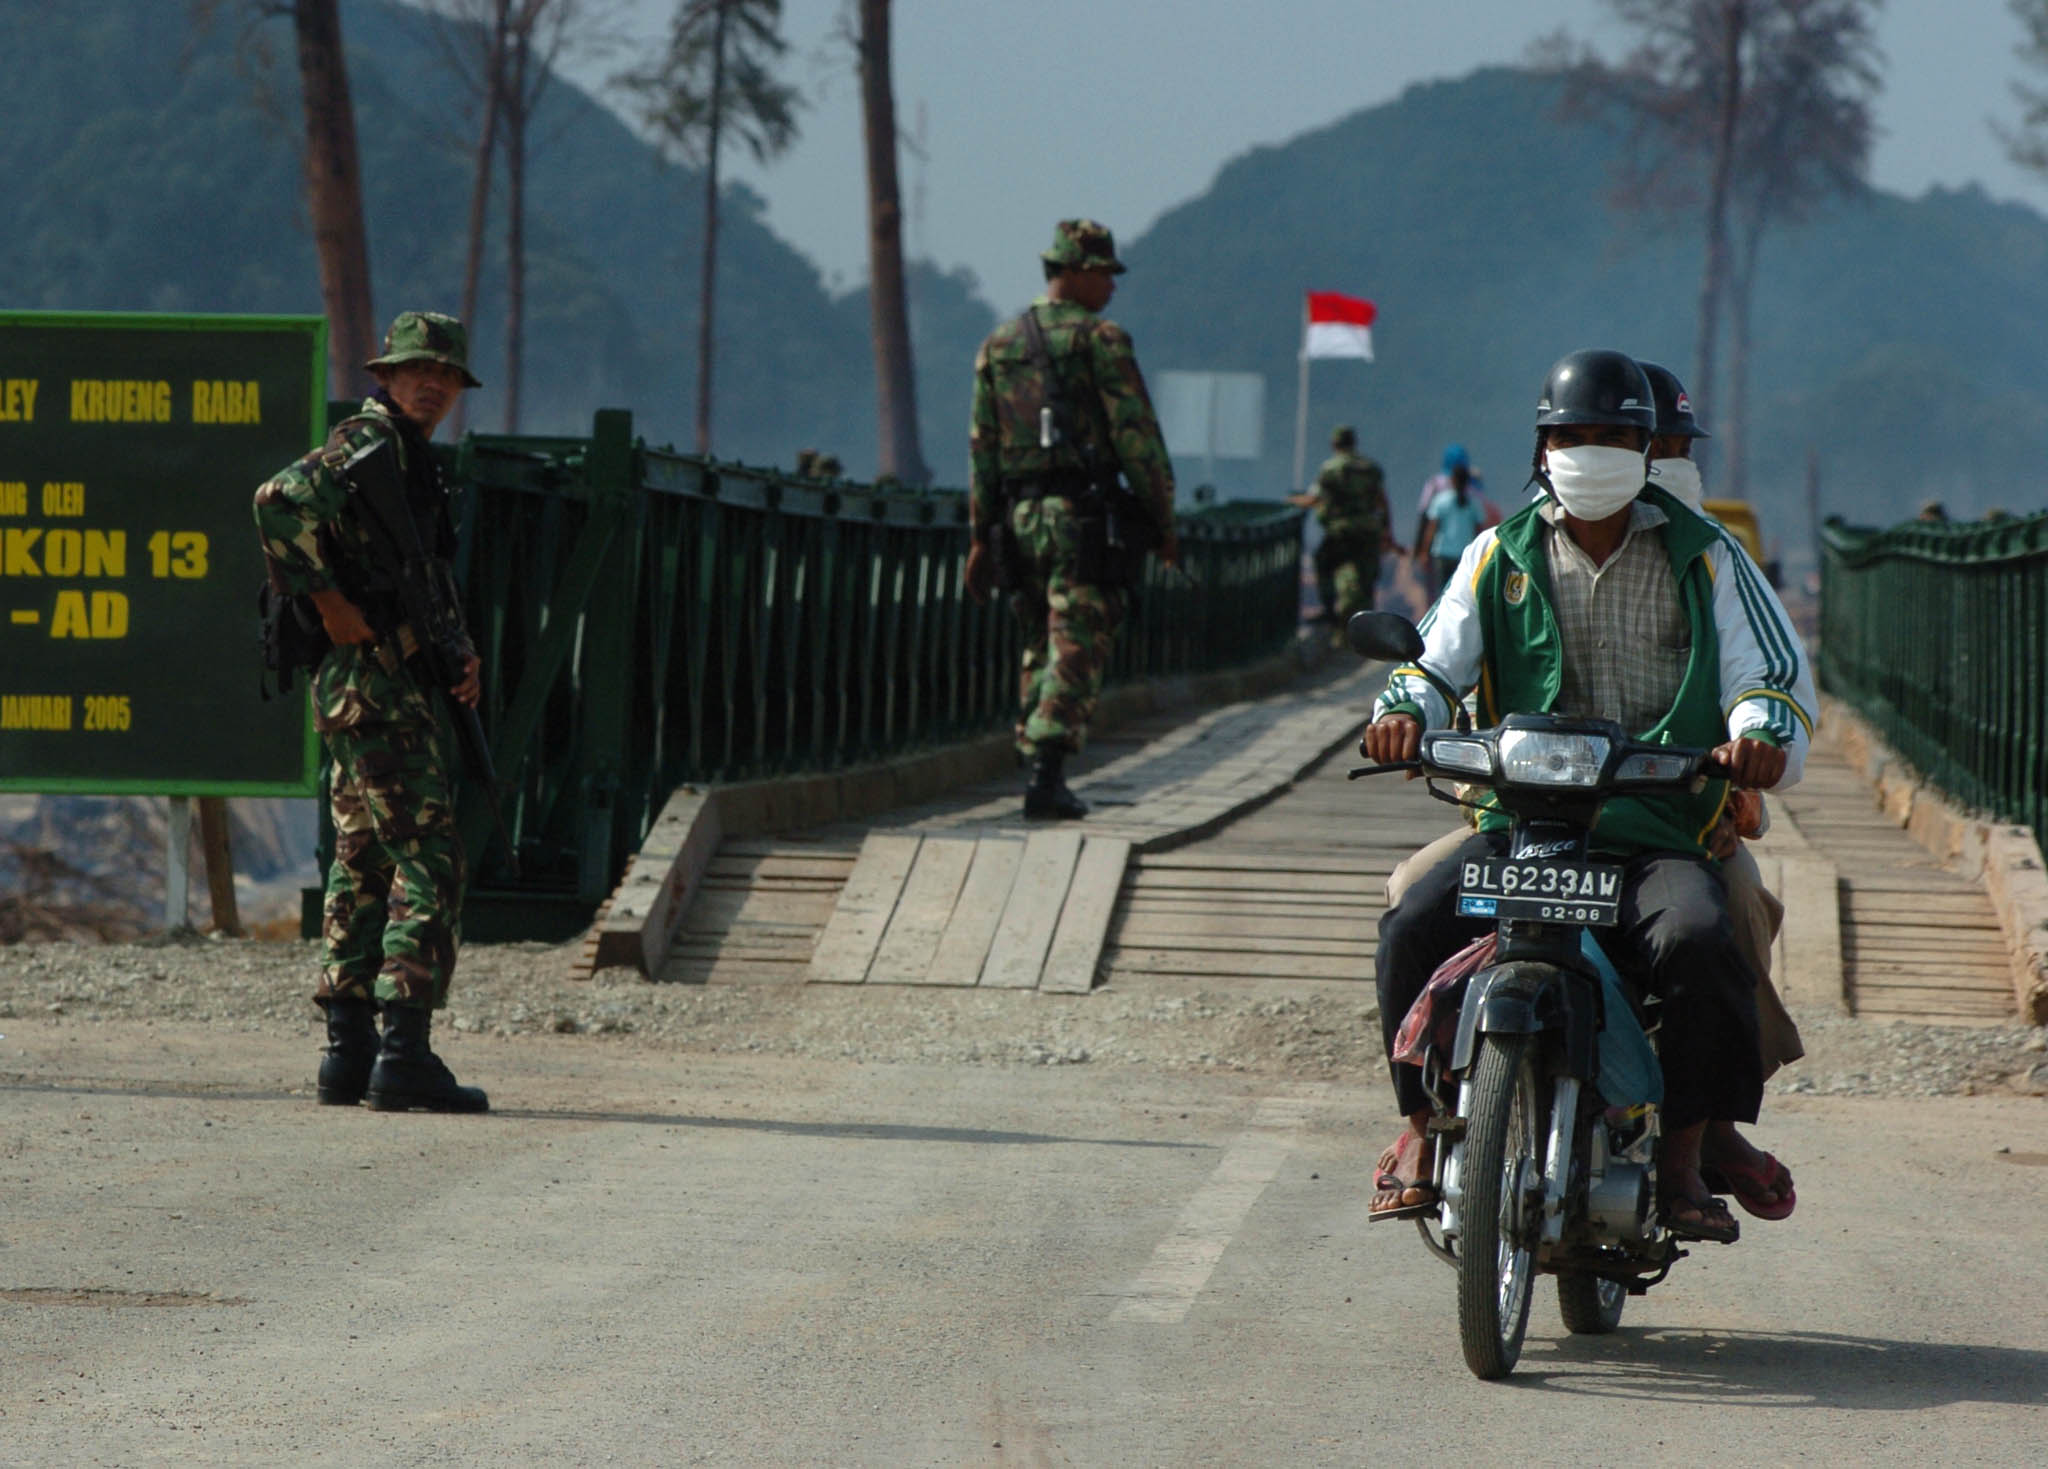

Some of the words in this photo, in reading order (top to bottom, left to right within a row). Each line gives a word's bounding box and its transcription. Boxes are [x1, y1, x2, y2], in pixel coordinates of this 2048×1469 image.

[71, 380, 171, 422] KRUENG
[193, 381, 260, 423] RABA
[42, 482, 85, 516] OLEH
[0, 528, 126, 577] KON
[148, 531, 209, 578] 13
[0, 696, 72, 731] JANUARI
[84, 696, 131, 731] 2005
